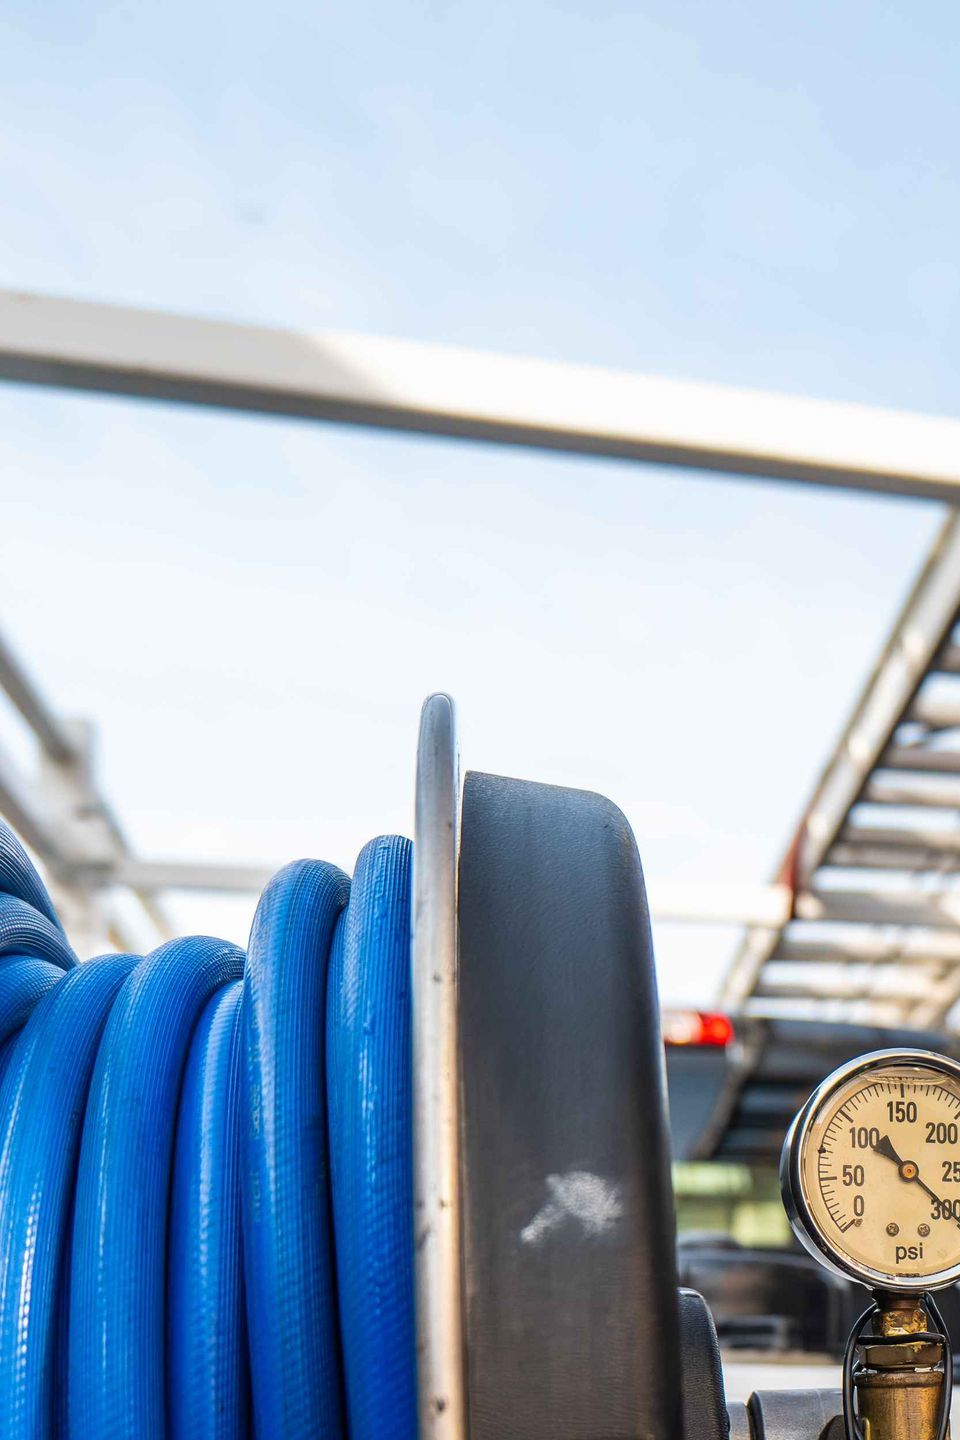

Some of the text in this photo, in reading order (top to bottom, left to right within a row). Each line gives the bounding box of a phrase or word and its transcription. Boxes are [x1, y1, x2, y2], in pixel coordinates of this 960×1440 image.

[887, 1101, 917, 1123] 150
[850, 1127, 880, 1148] 100
[925, 1122, 958, 1144] 200
[843, 1165, 864, 1186] 50
[854, 1196, 864, 1216] 0
[895, 1243, 923, 1264] psi
